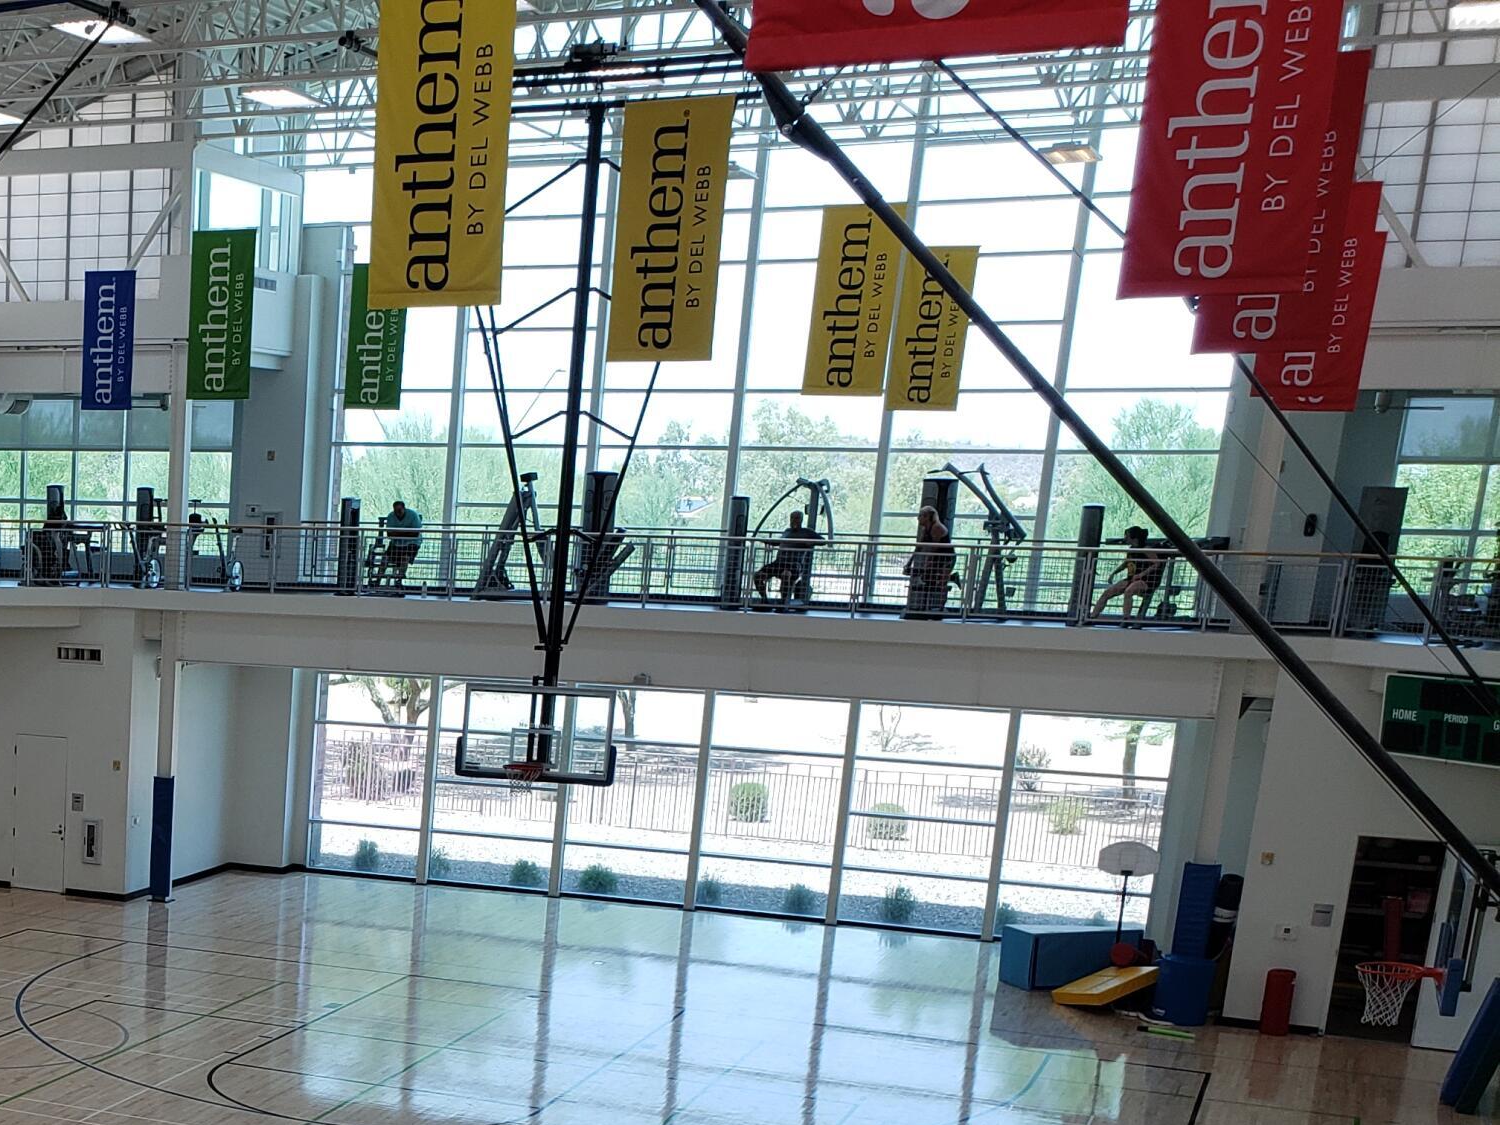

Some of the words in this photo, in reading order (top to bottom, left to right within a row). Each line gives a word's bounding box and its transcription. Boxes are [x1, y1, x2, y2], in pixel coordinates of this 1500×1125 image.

[1279, 0, 1313, 82] WEB
[472, 43, 494, 127] WEBB
[1269, 93, 1301, 158] DEL
[469, 136, 489, 189] DEL
[692, 165, 711, 227] WEBB
[1261, 173, 1289, 212] BY
[466, 203, 485, 235] BY
[688, 234, 706, 274] DEL
[1338, 238, 1358, 288] WEBB
[871, 252, 888, 298] WEBB
[234, 272, 245, 313] WEBB
[685, 284, 701, 308] BY
[119, 306, 128, 340] WEBB
[389, 309, 399, 335] WEB
[867, 304, 881, 333] DEL
[1332, 294, 1349, 326] DEL
[232, 317, 243, 343] DEL
[943, 331, 957, 358] DEL
[1327, 333, 1343, 353] BY
[117, 343, 126, 364] DEL
[231, 349, 241, 366] BY
[356, 309, 385, 404] anthe
[387, 340, 397, 363] DEL
[863, 342, 876, 358] BY
[117, 367, 125, 382] BY
[385, 367, 394, 382] BY
[941, 361, 952, 379] BY
[1392, 708, 1418, 722] HOME
[1443, 713, 1469, 725] PERIOD
